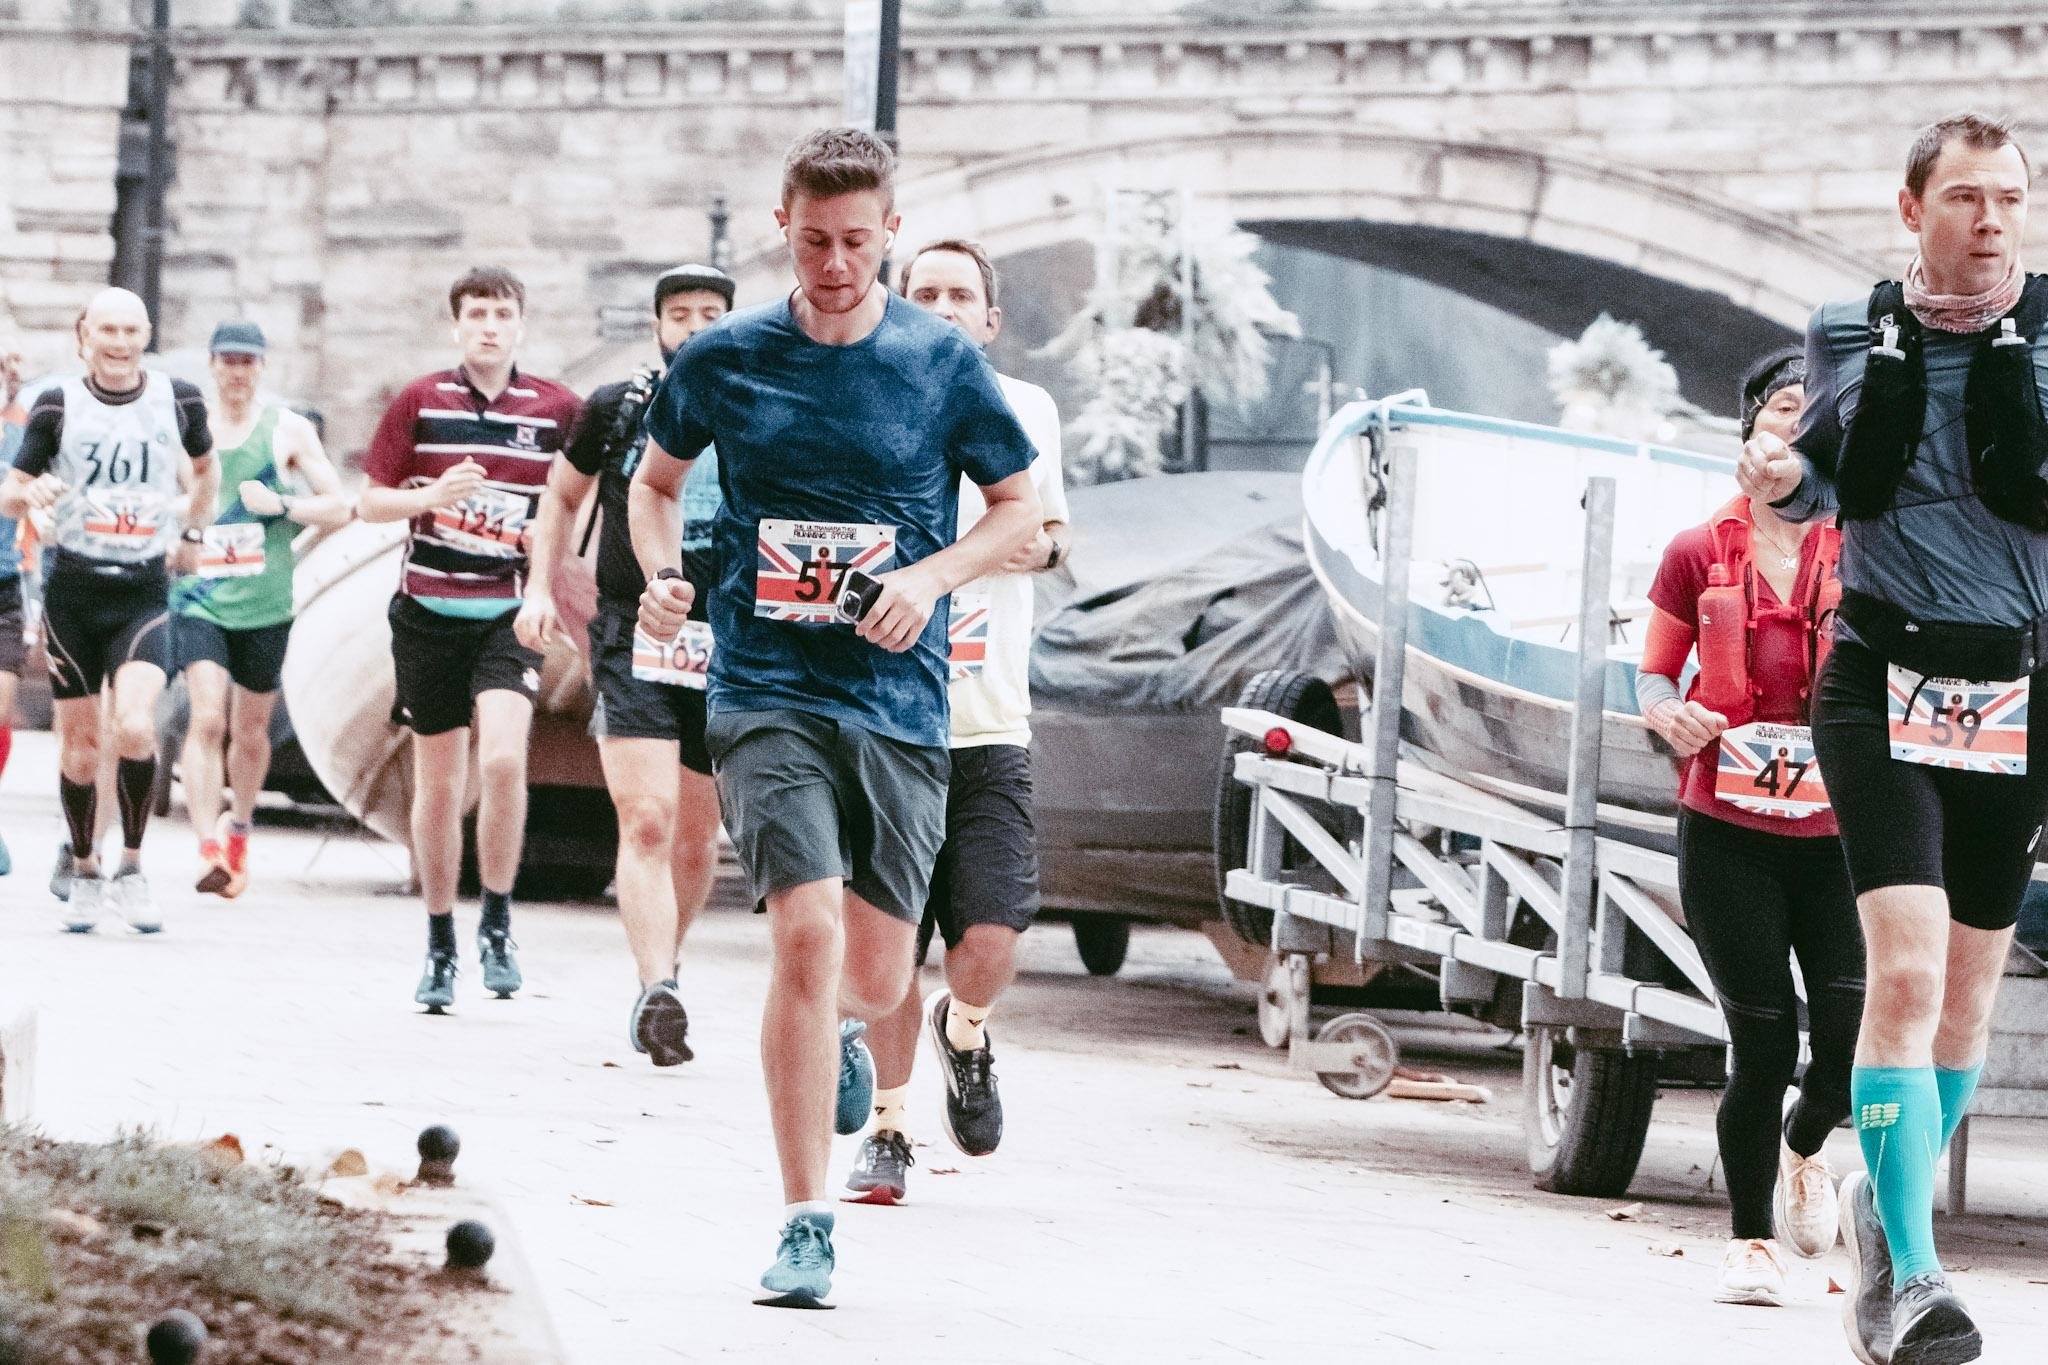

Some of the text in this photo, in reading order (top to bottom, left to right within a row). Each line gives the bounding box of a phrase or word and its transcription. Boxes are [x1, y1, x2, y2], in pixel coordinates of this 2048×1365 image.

[80, 441, 148, 495] 361
[115, 512, 138, 534] 19
[459, 509, 504, 541] 124
[794, 530, 827, 539] RUNNING
[795, 561, 852, 602] 57
[660, 645, 708, 674] 102
[1929, 705, 1982, 749] 59
[1754, 759, 1808, 798] 47
